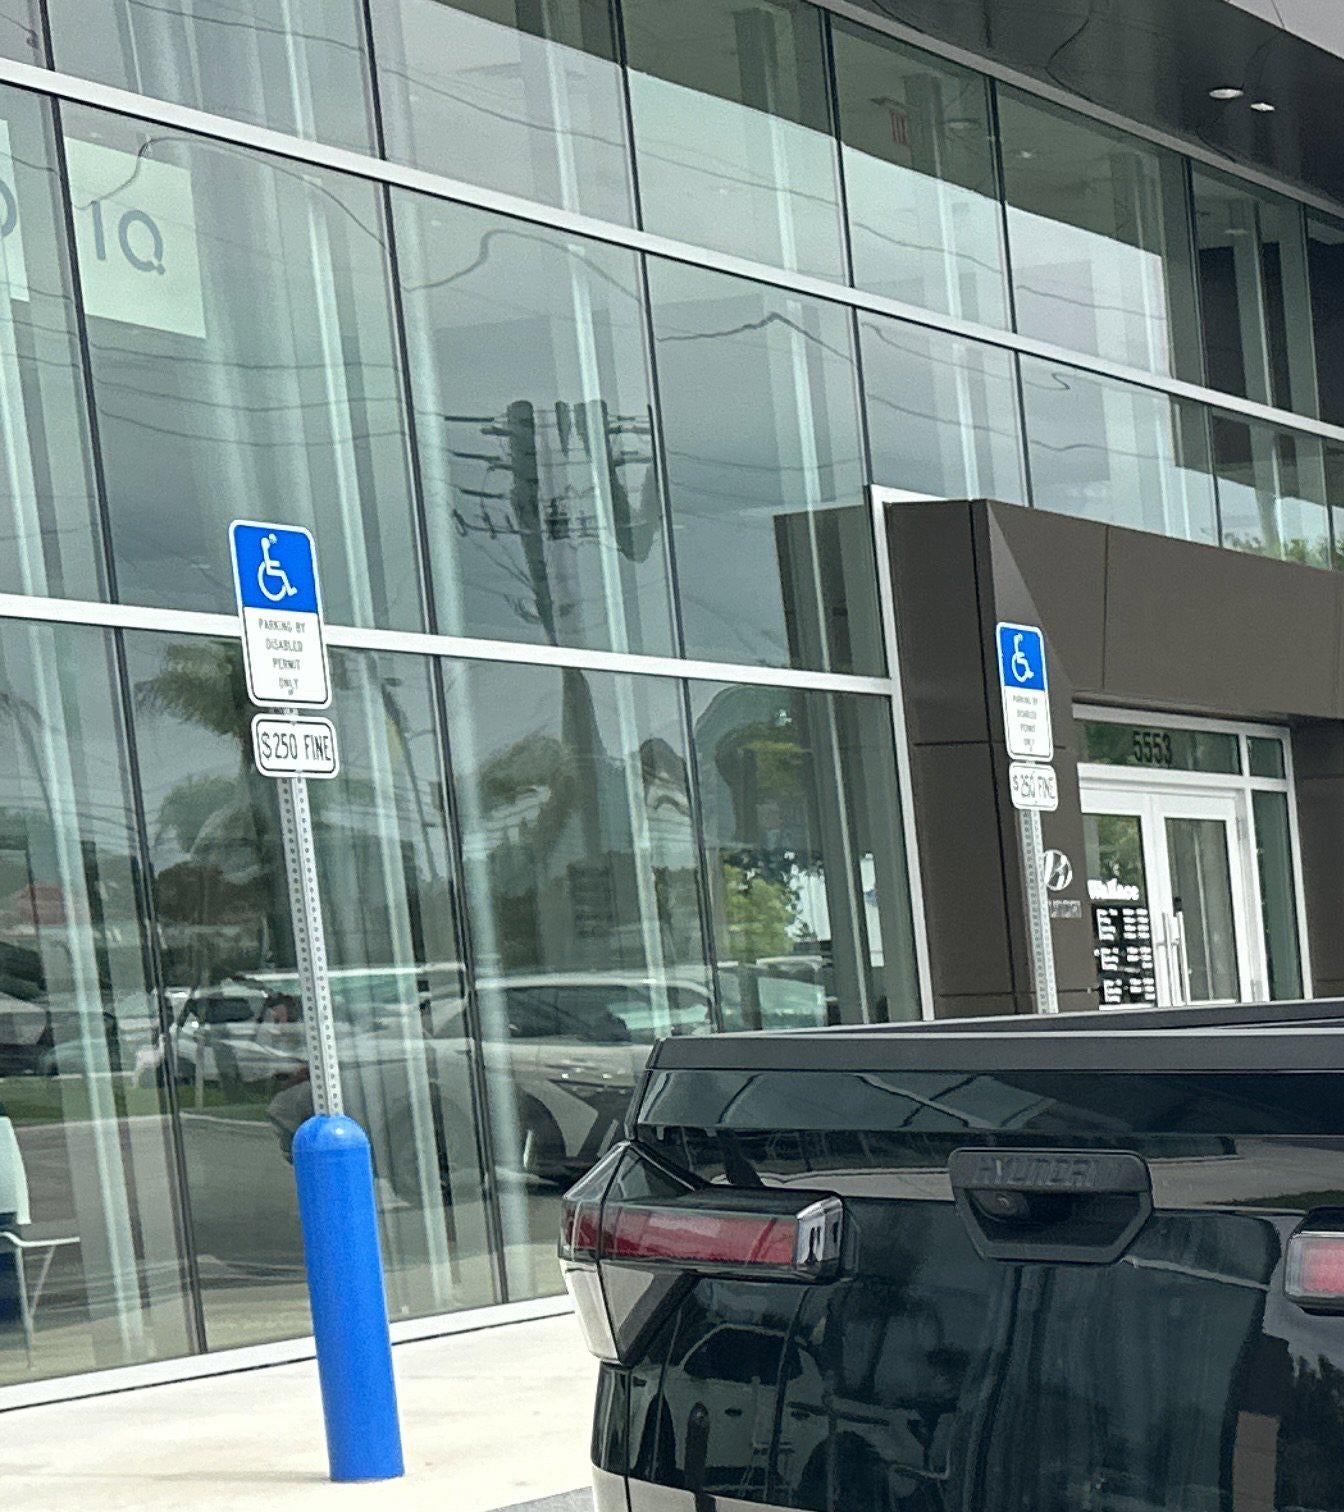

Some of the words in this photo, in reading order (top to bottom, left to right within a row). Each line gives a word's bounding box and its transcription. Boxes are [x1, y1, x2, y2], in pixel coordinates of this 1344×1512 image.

[260, 730, 298, 761] $250
[303, 733, 332, 762] FINE
[1131, 729, 1173, 767] 5553
